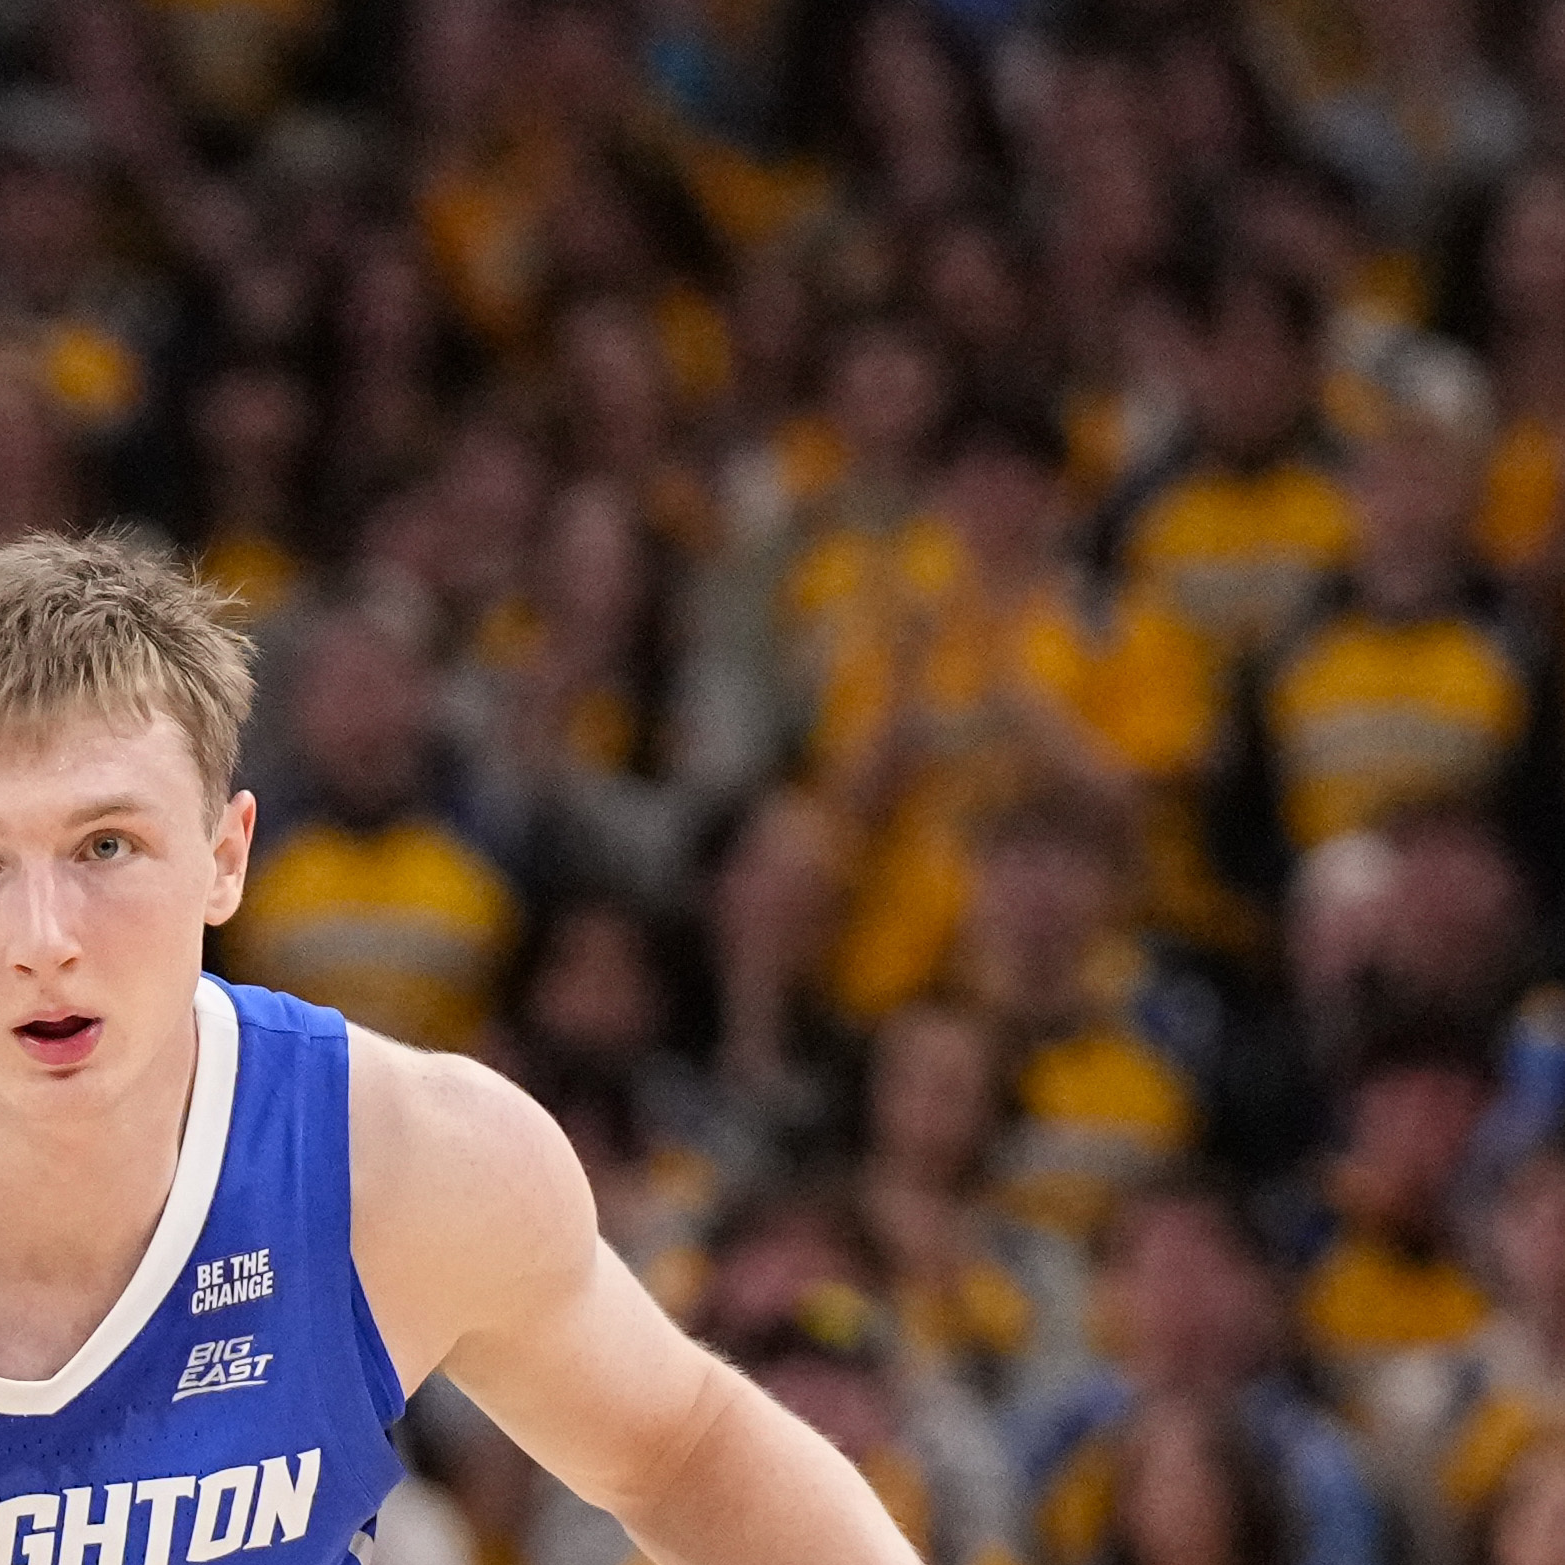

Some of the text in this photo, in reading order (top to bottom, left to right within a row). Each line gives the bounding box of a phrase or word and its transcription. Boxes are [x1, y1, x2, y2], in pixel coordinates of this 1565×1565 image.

[197, 1248, 270, 1289] BE THE
[191, 1271, 274, 1314] CHANGE
[187, 1335, 254, 1367] BIG
[177, 1354, 274, 1389] EAST
